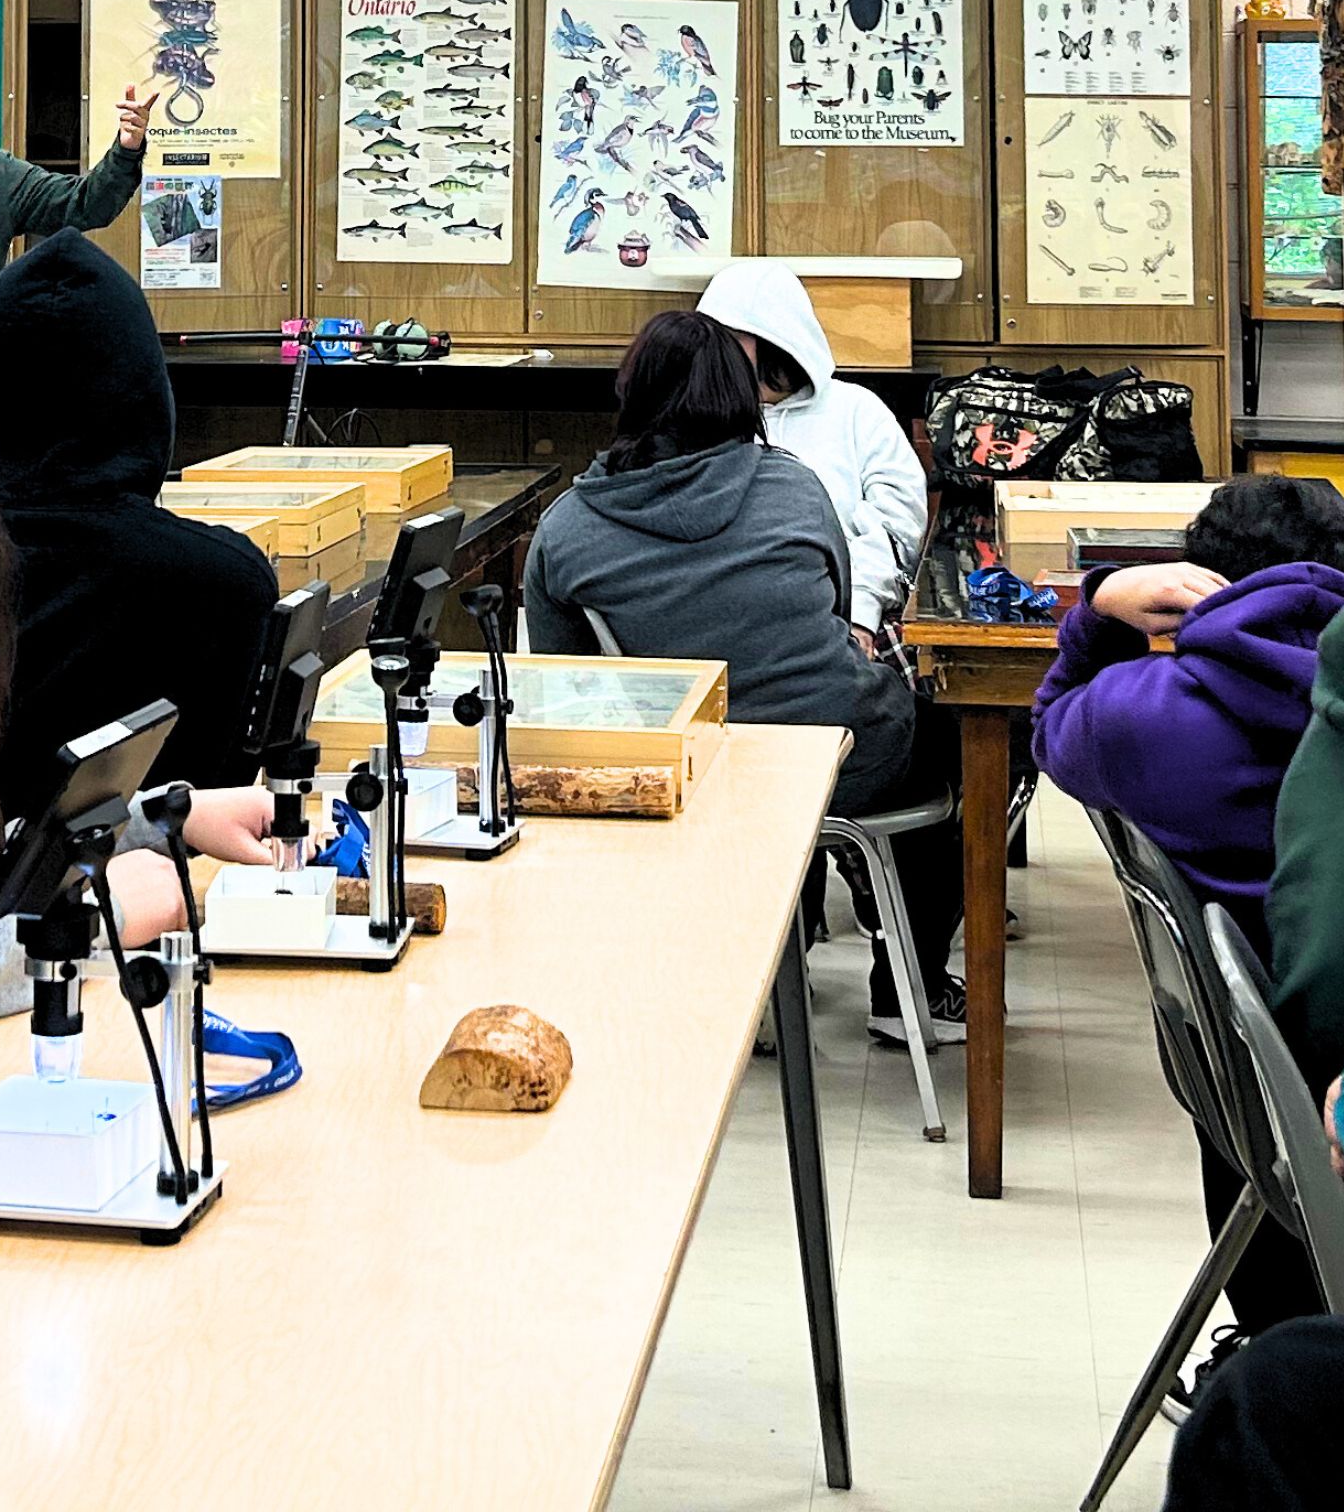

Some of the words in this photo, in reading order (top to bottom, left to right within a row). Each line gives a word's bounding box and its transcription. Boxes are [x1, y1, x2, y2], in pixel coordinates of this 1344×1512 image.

[814, 110, 840, 128] Bug
[843, 113, 874, 128] your
[875, 110, 925, 125] Parents
[790, 128, 803, 140] to
[804, 129, 842, 140] come
[845, 128, 859, 140] to
[861, 125, 884, 140] the
